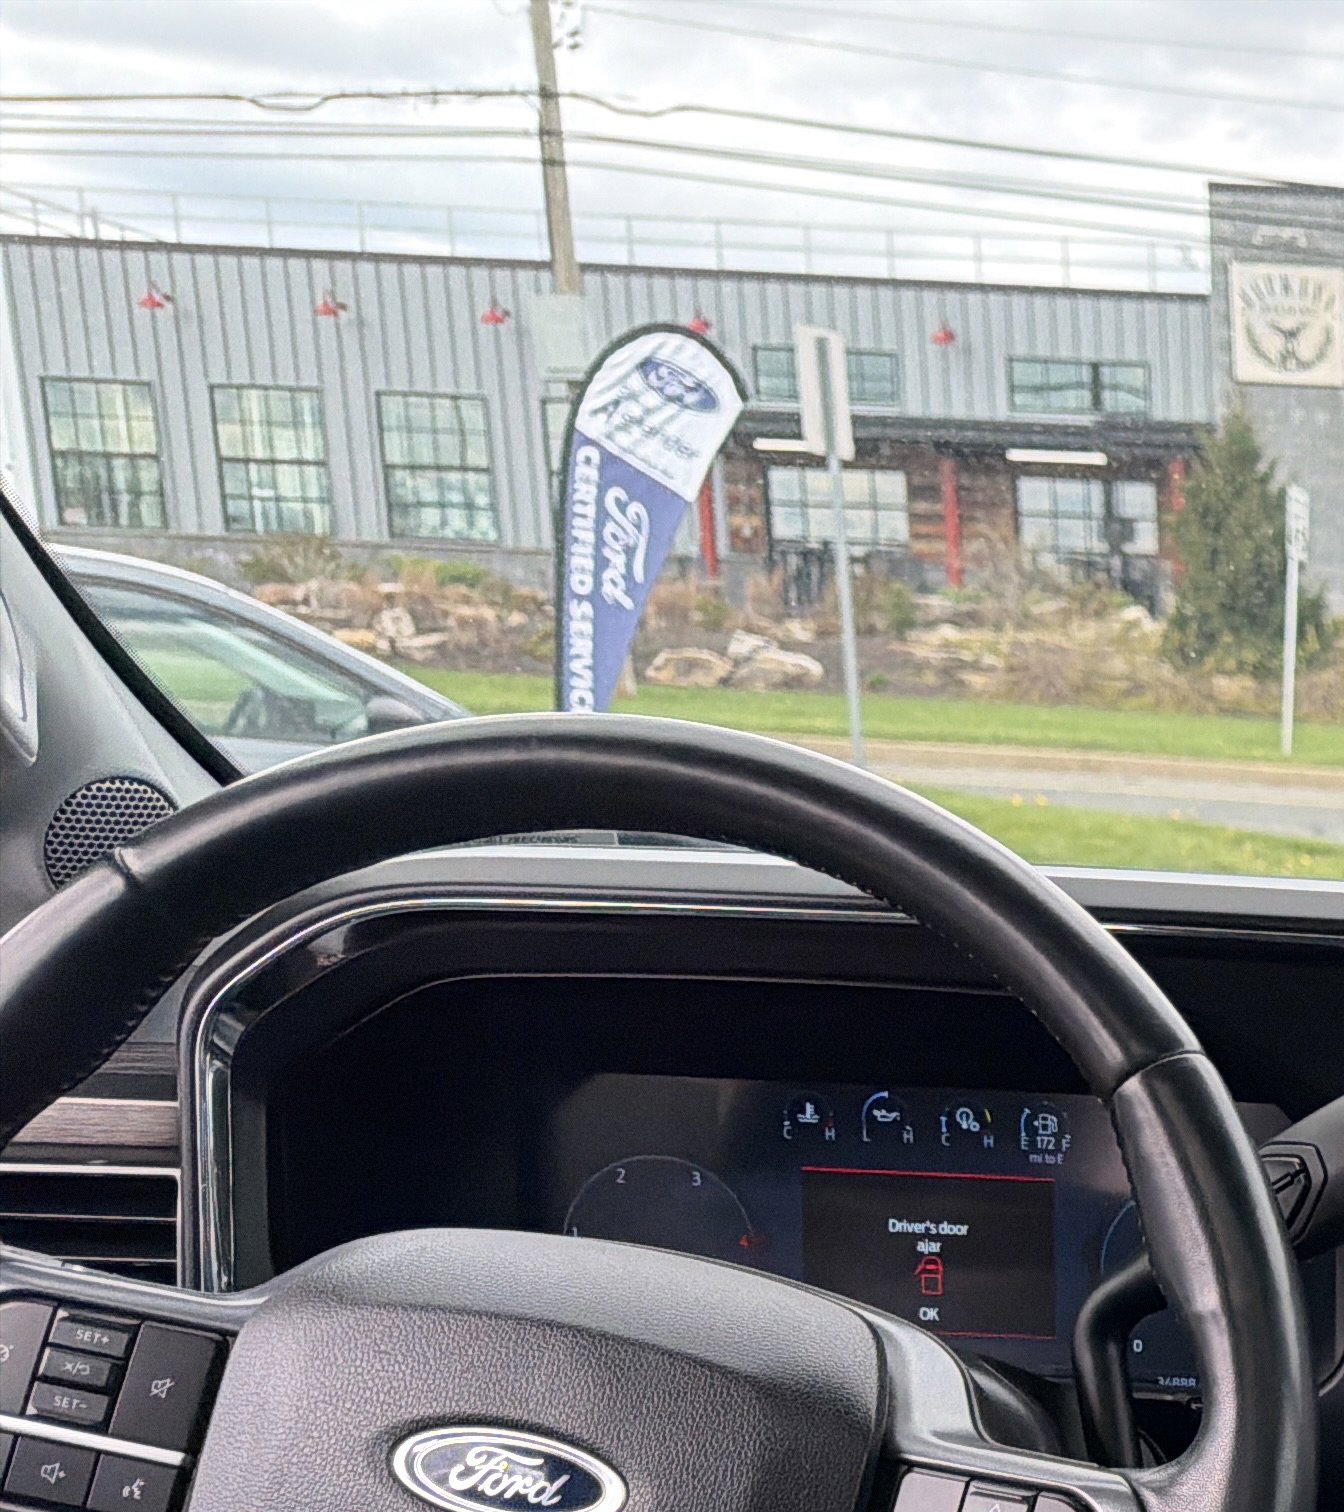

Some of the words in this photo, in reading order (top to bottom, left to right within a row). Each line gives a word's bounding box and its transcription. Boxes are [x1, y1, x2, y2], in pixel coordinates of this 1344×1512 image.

[567, 444, 600, 596] CERTIFIED
[602, 486, 650, 611] Ford
[568, 597, 596, 713] SERVIC
[825, 1128, 836, 1141] H
[983, 1136, 994, 1148] H
[1020, 1136, 1029, 1150] E
[1036, 1137, 1056, 1150] 172
[1029, 1152, 1042, 1163] mi
[1045, 1153, 1055, 1164] to
[1057, 1154, 1064, 1165] E
[615, 1168, 626, 1184] 2
[691, 1171, 702, 1187] 3
[888, 1218, 937, 1235] Driver's
[938, 1221, 969, 1236] door
[916, 1238, 942, 1254] ajar
[919, 1306, 939, 1321] OK
[1132, 1339, 1143, 1353] 0
[449, 1446, 570, 1506] Ford
